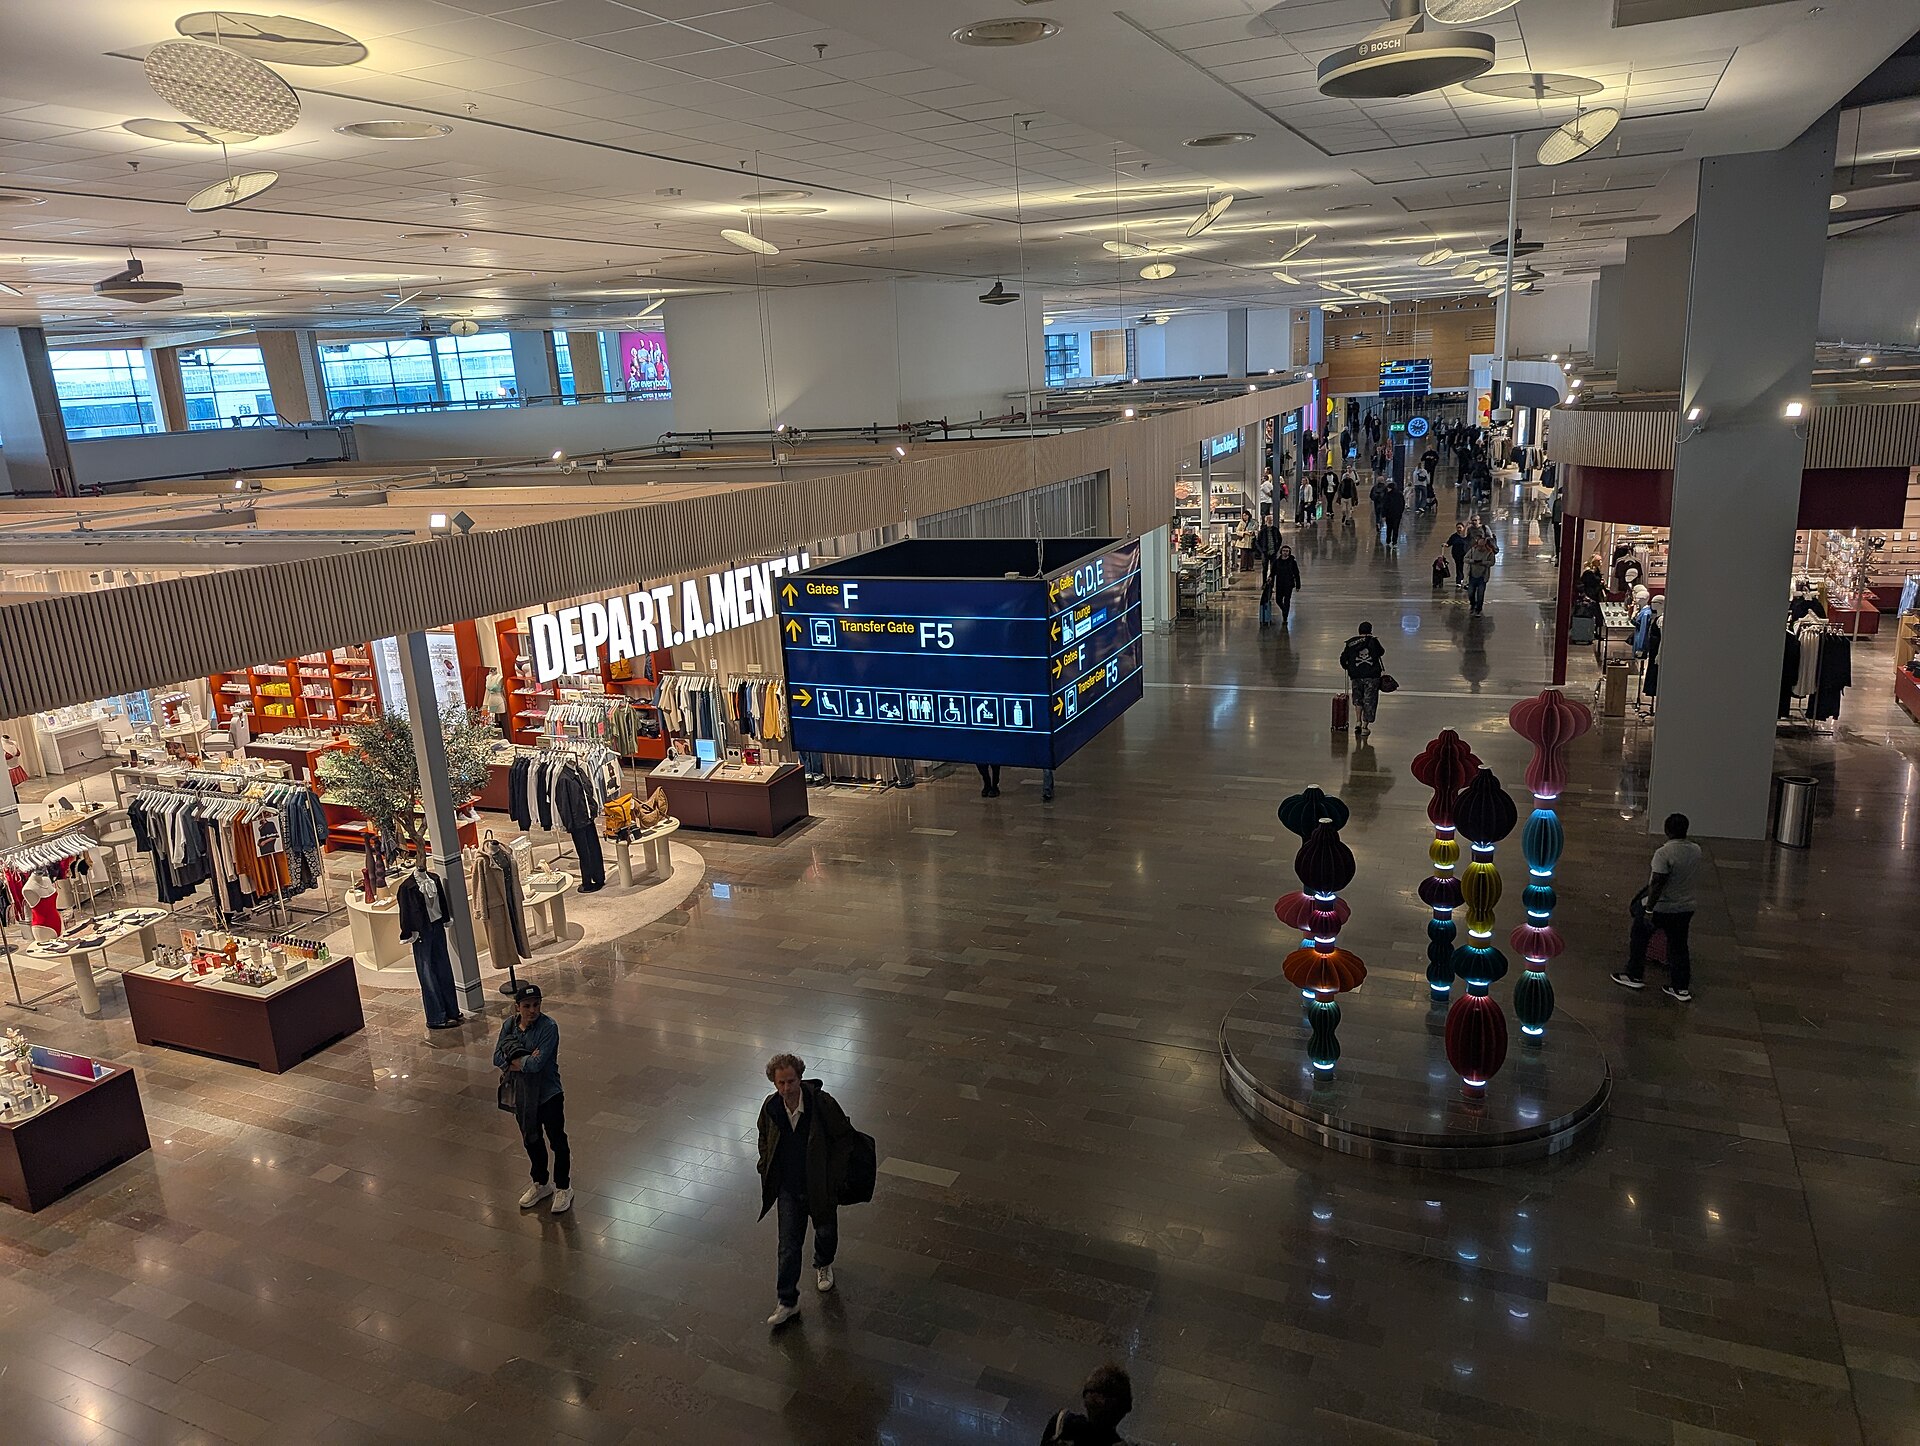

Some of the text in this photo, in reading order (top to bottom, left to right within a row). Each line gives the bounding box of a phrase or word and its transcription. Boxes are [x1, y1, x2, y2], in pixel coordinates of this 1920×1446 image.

[1371, 39, 1400, 52] BOSCH
[631, 380, 640, 388] For
[239, 405, 251, 414] F33
[1060, 576, 1074, 590] Gates
[806, 583, 859, 609] Gates F
[530, 552, 811, 684] DEPART.A.MENT
[1074, 604, 1091, 622] Lounge
[839, 619, 955, 649] Transfer Gate F5
[1064, 643, 1086, 671] Gates F
[1078, 658, 1118, 694] Transfer Gate F5
